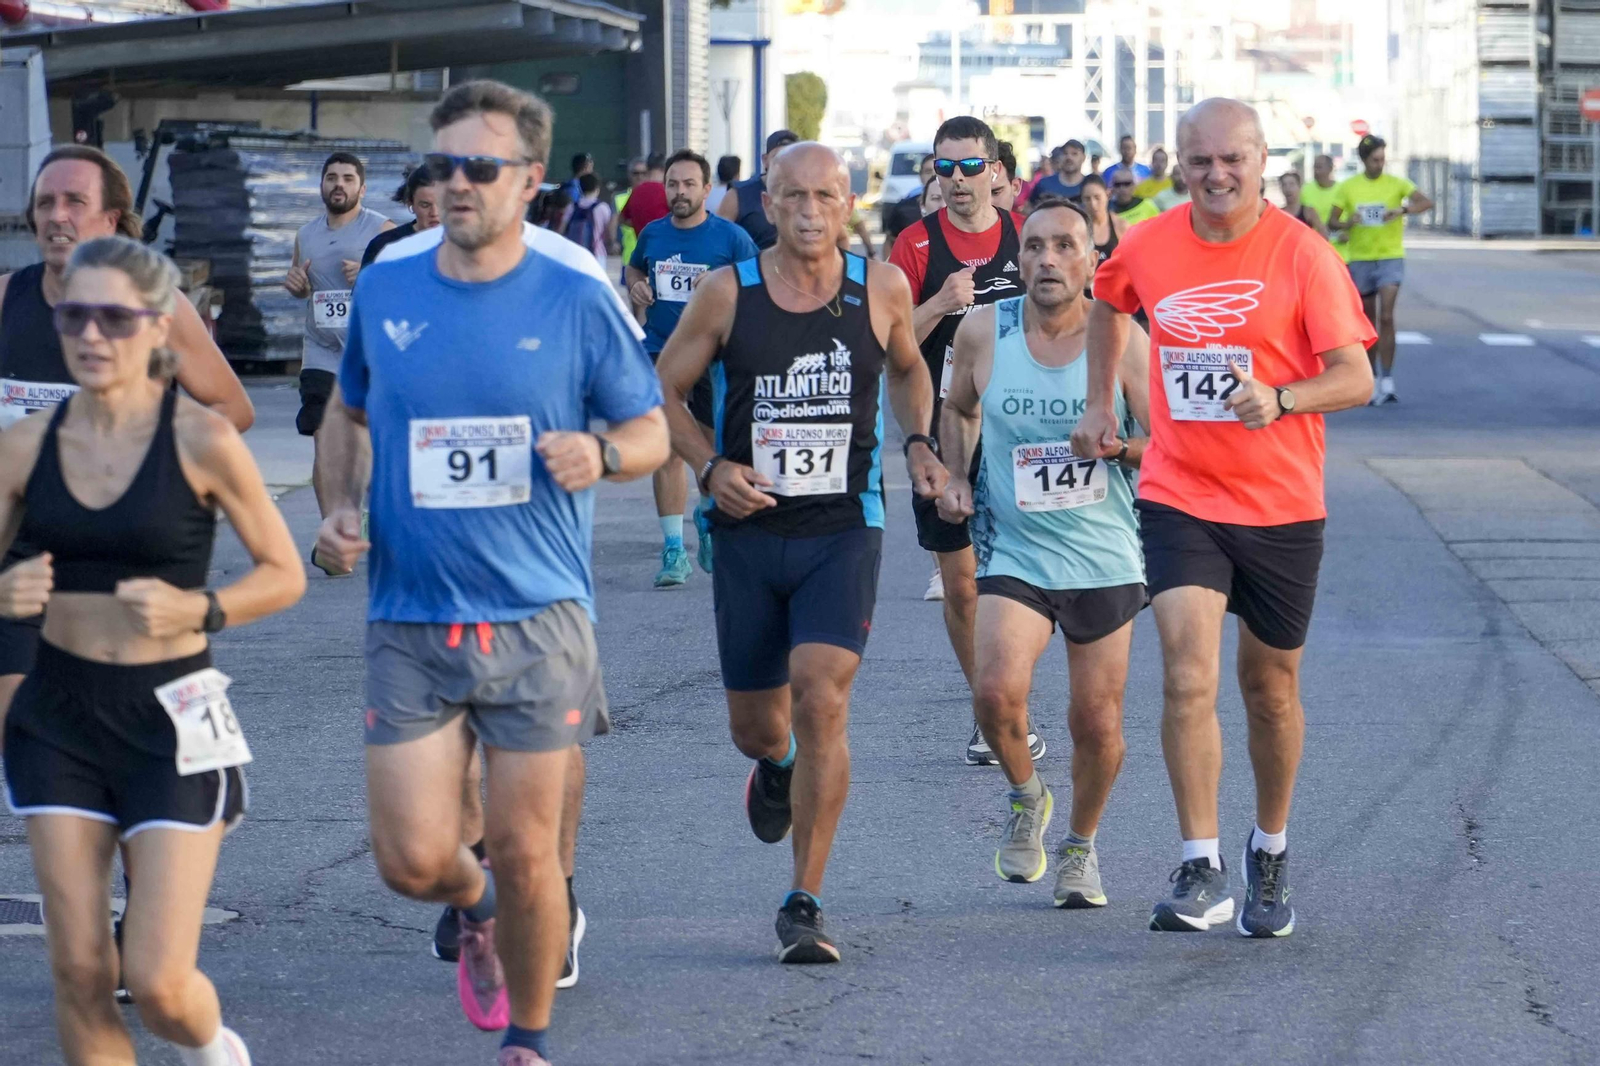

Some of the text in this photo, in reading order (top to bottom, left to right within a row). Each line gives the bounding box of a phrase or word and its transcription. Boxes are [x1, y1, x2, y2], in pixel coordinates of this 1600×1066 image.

[326, 303, 347, 317] 39
[829, 351, 852, 367] 15K
[1164, 351, 1248, 364] 10KMS ALFONSO MORO
[4, 383, 26, 398] 10KMS
[28, 387, 67, 400] ALFONSO
[1175, 371, 1240, 400] 142
[753, 402, 851, 423] mediolanum
[450, 424, 495, 438] ALFONSO
[757, 427, 848, 439] 10KMS ALFONSO MORO
[1017, 445, 1073, 459] 10KMS ALFON
[447, 448, 498, 482] 91
[773, 447, 834, 476] 131
[1034, 460, 1097, 492] 147
